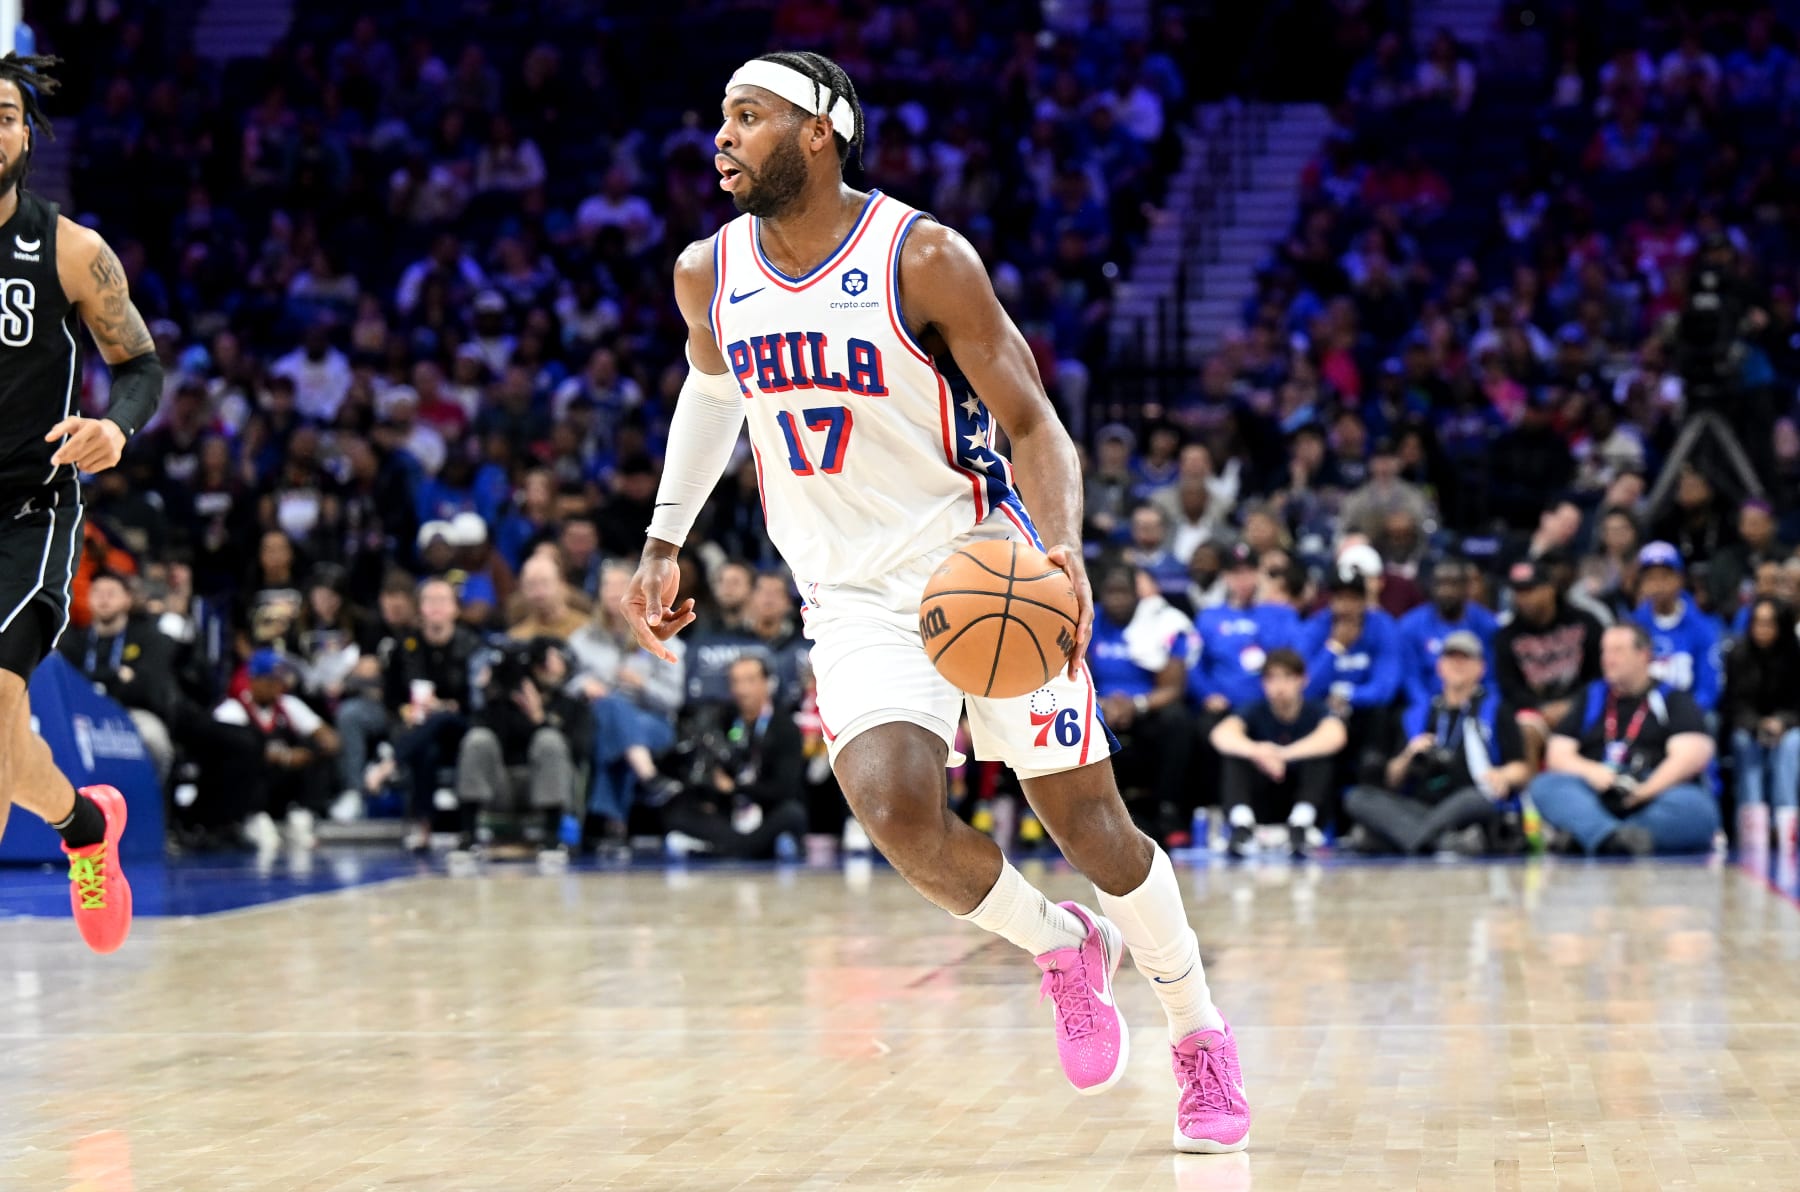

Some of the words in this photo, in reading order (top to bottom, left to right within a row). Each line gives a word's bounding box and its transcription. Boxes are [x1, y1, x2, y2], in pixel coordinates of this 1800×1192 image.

[829, 300, 880, 309] crypto.com
[727, 331, 889, 398] PHILA
[776, 406, 853, 476] 17
[1030, 707, 1082, 747] 76
